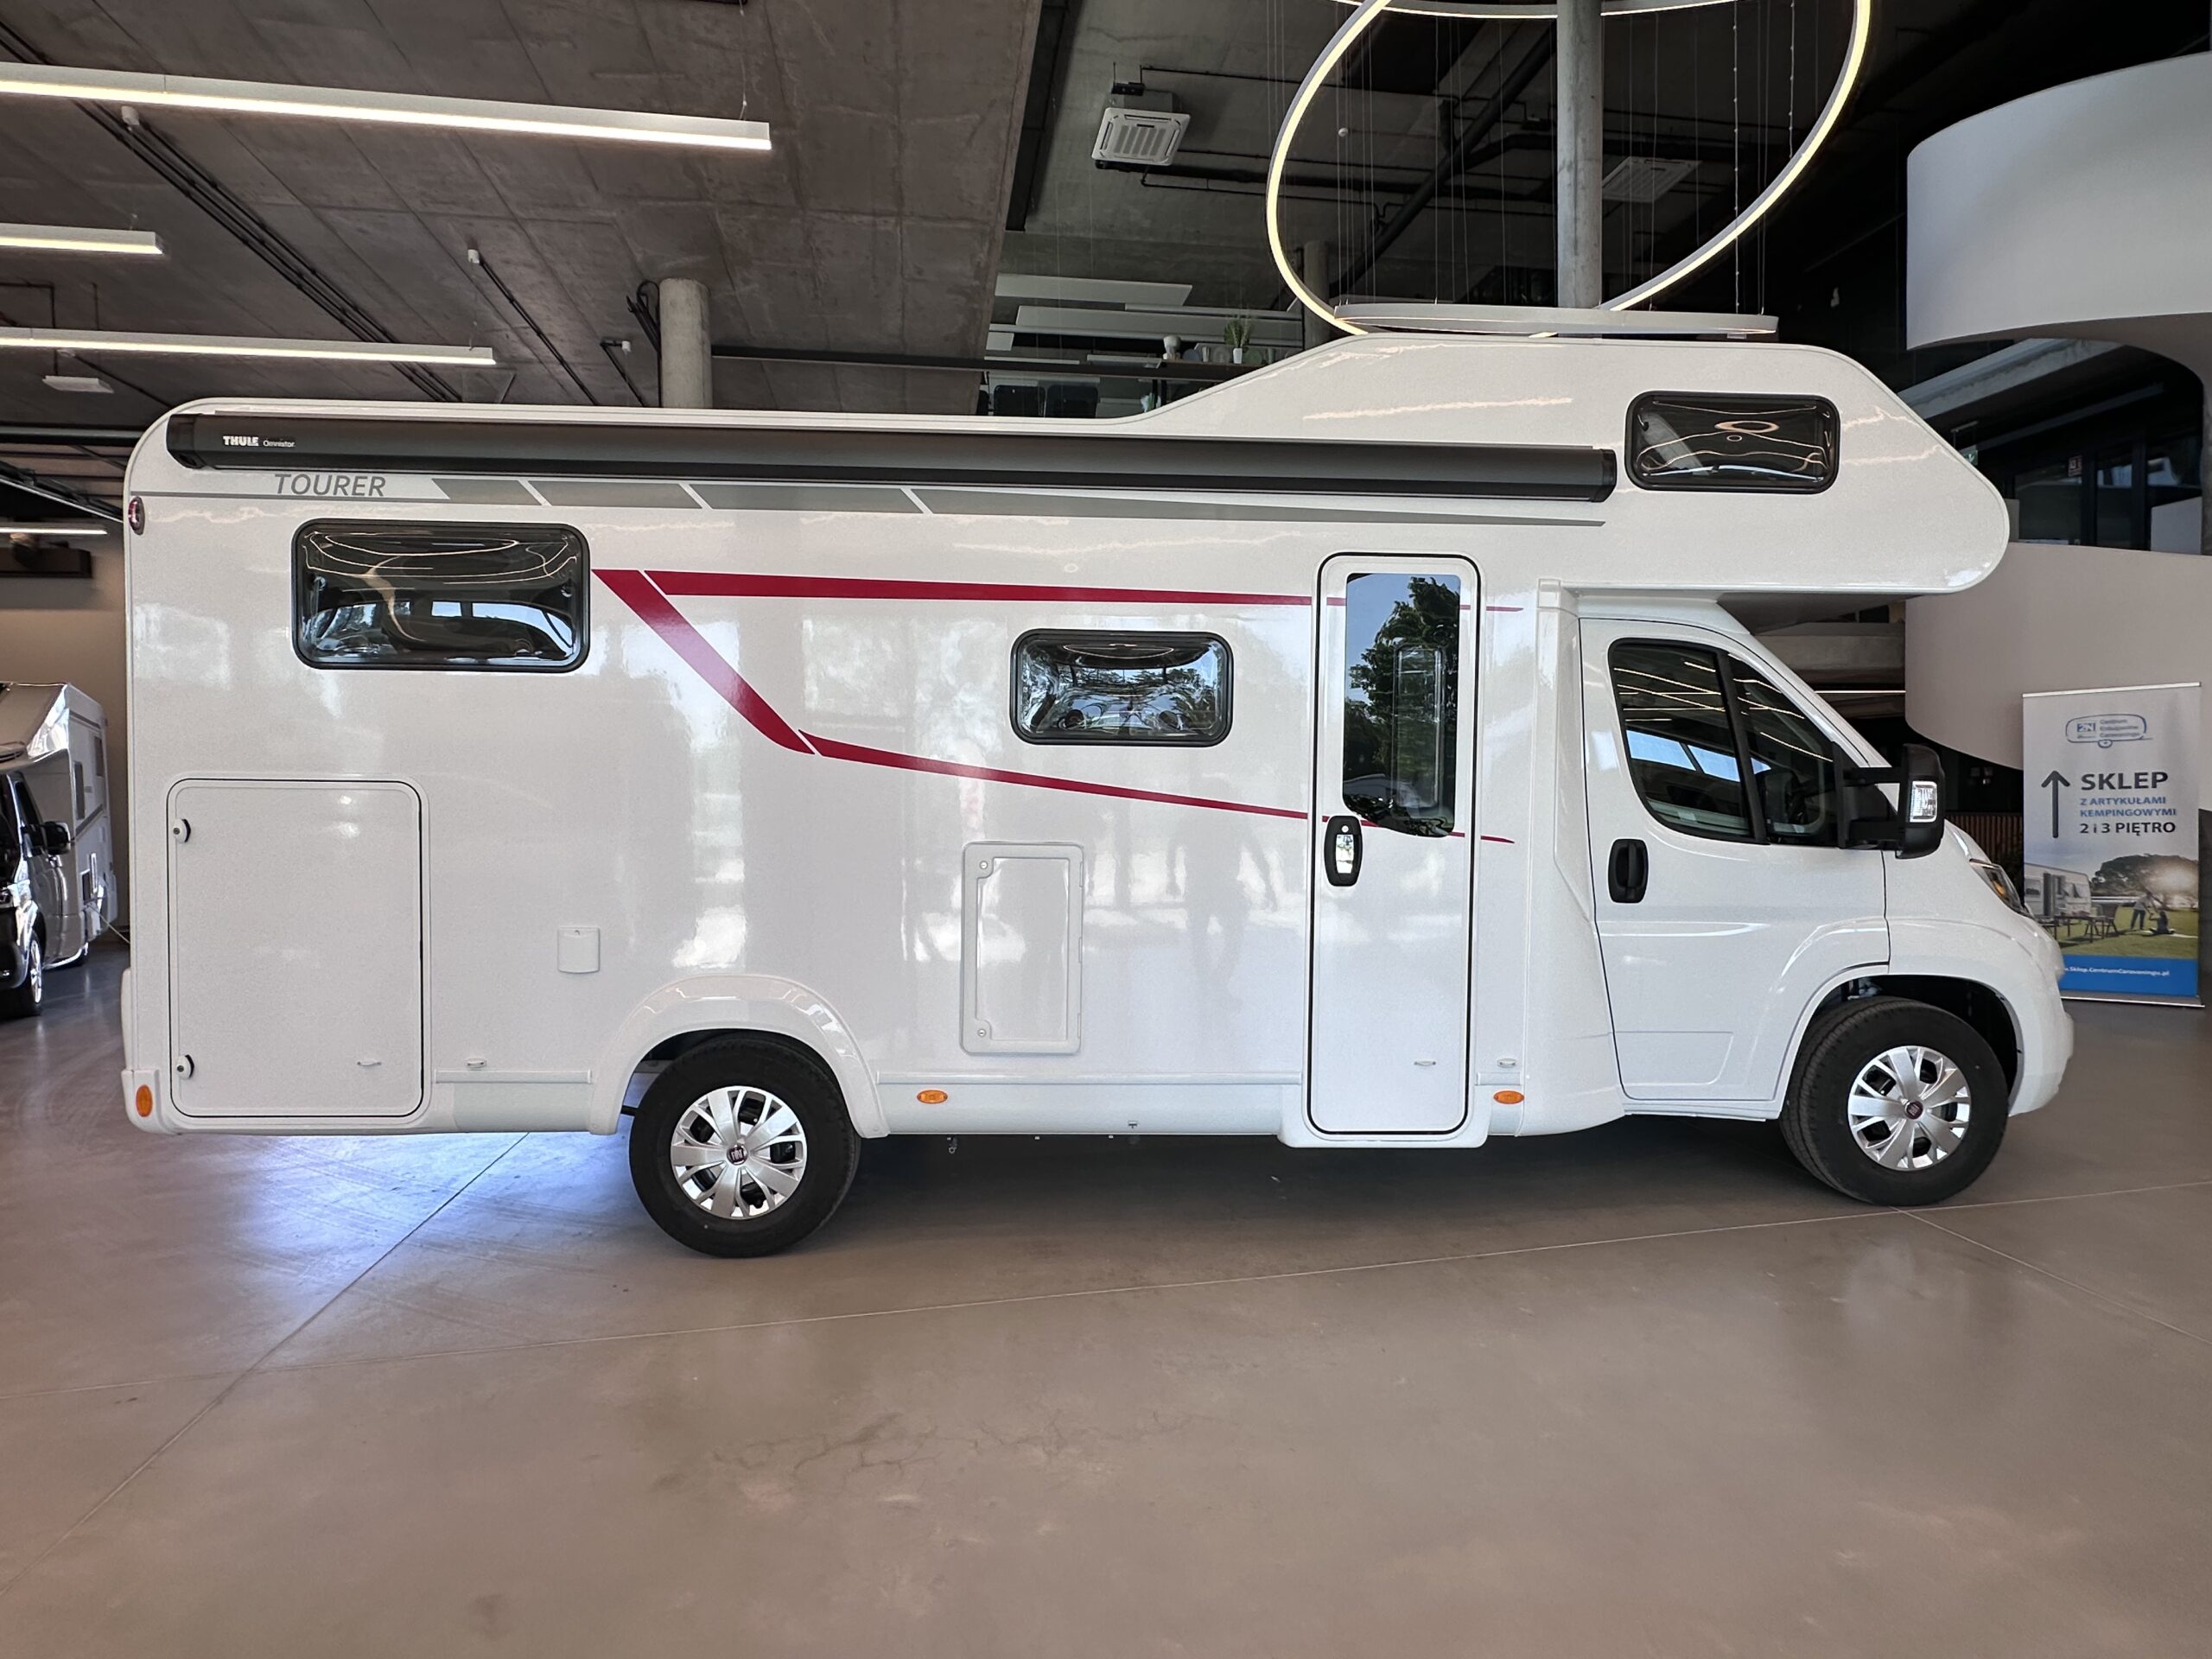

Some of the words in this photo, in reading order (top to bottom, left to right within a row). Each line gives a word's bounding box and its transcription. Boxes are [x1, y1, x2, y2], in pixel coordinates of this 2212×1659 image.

[223, 435, 259, 447] THULE
[275, 474, 386, 497] TOURER
[2081, 771, 2169, 791] SKLEP
[2080, 798, 2087, 806] Z
[2089, 796, 2166, 805] ARTYKUŁAMI
[2080, 808, 2177, 817] KEMPINGOWYMI
[2080, 823, 2089, 834] 2
[2093, 823, 2097, 834] i
[2101, 823, 2110, 834] 3
[2115, 822, 2177, 836] PIĘTRO
